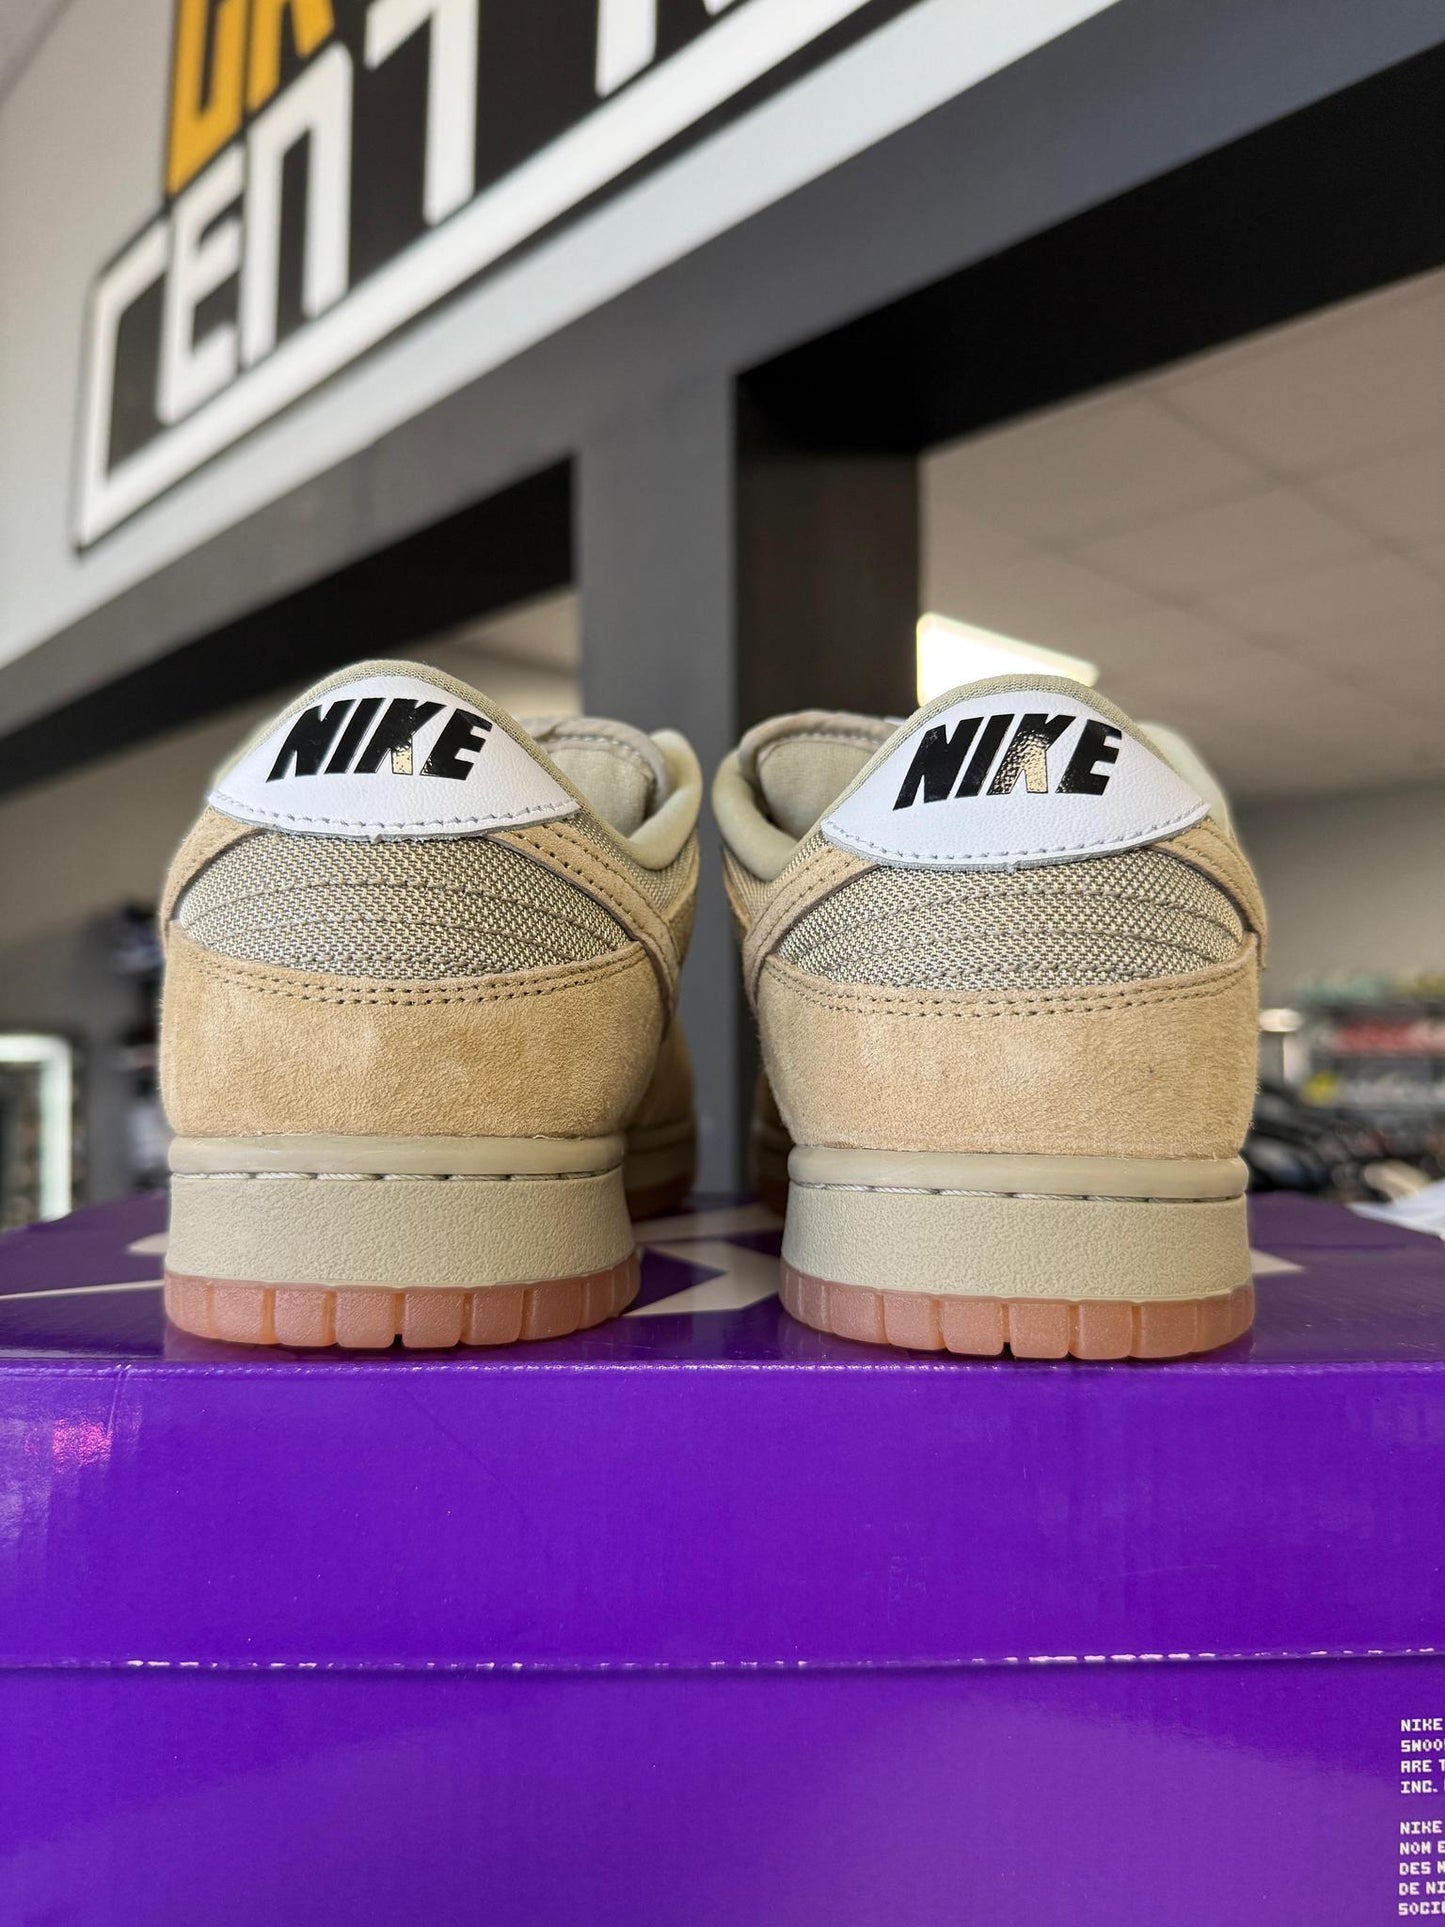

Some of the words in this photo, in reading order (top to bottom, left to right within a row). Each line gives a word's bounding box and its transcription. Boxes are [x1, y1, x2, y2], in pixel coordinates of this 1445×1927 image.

[266, 697, 493, 782] NIKE
[893, 713, 1122, 811] NIKE
[1401, 1718, 1443, 1732] NIKE
[1401, 1738, 1445, 1753] SWOO
[1401, 1760, 1432, 1773] ARE
[1401, 1780, 1438, 1794] INC.
[1400, 1820, 1443, 1835] NIKE
[1400, 1841, 1431, 1856] NOM
[1399, 1861, 1431, 1876] DES
[1399, 1882, 1420, 1896] DE
